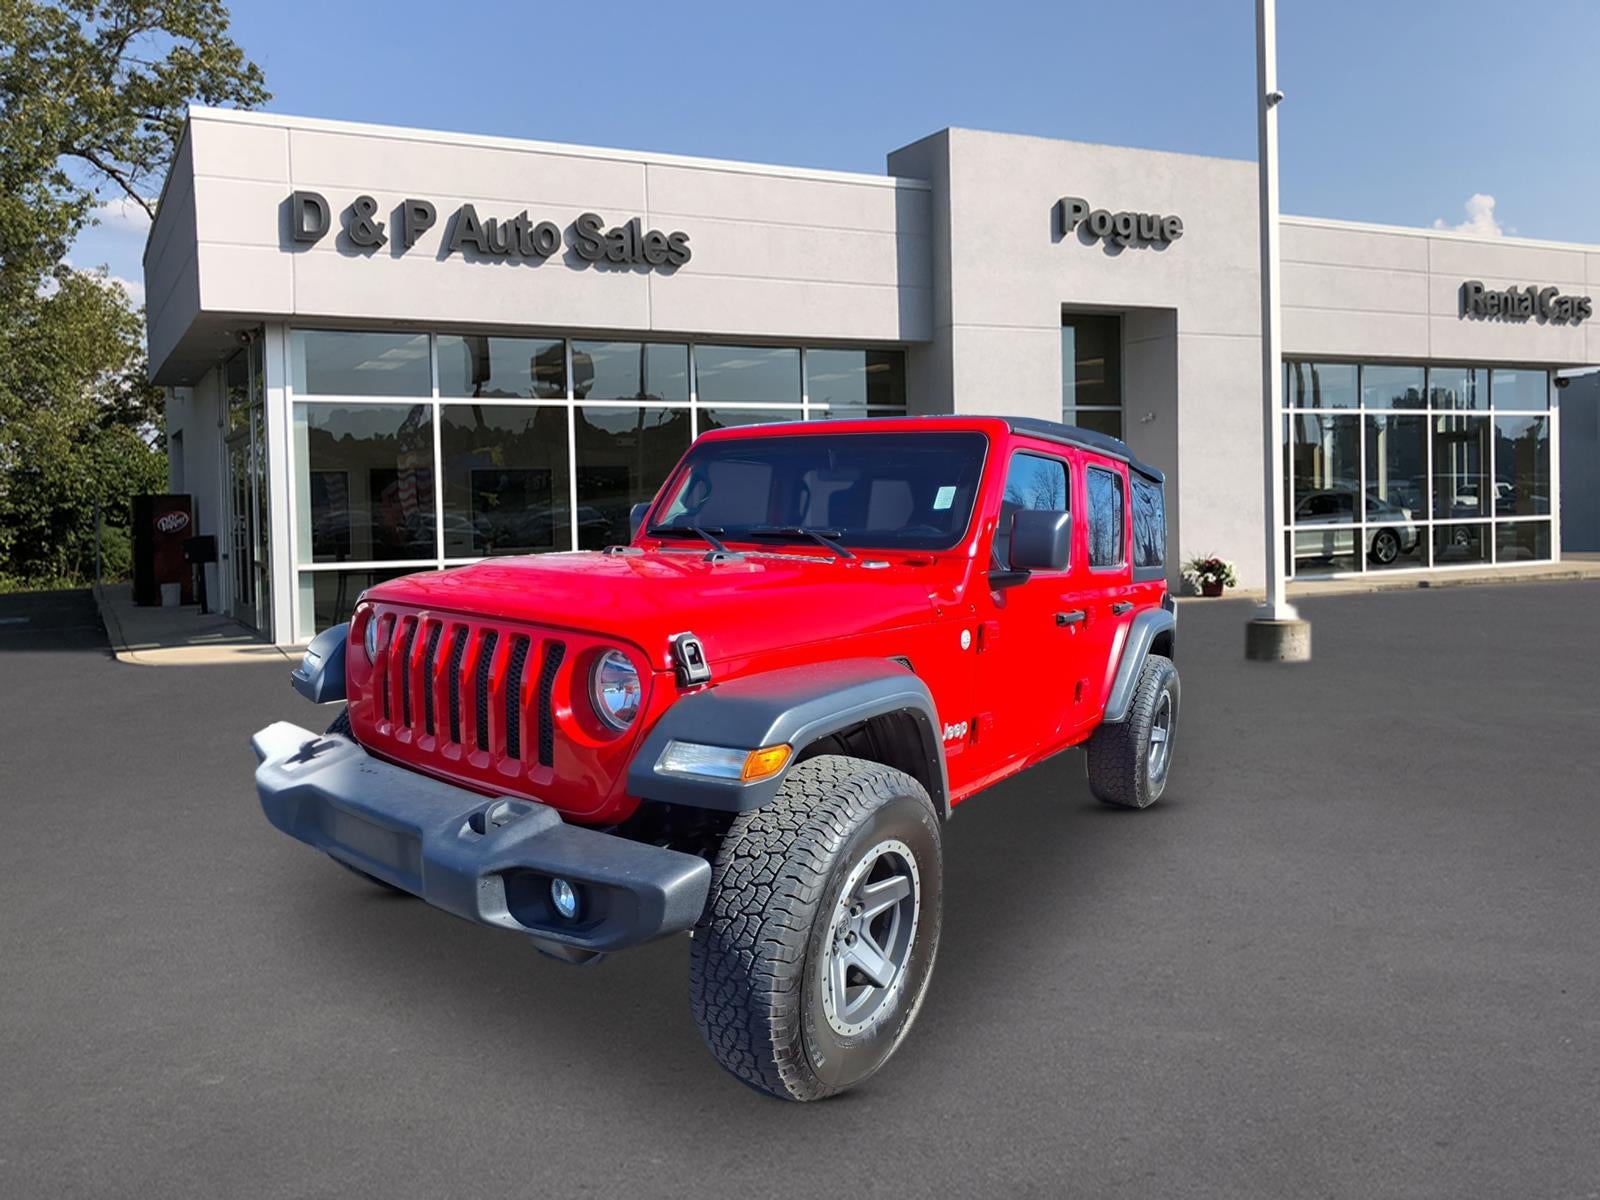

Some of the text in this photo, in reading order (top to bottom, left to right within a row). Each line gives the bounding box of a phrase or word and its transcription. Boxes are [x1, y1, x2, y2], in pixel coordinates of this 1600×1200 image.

[293, 190, 692, 267] D & P Auto Sales
[1060, 196, 1184, 246] Pogue
[1463, 280, 1593, 322] Rental Cars
[942, 720, 968, 741] Jeep
